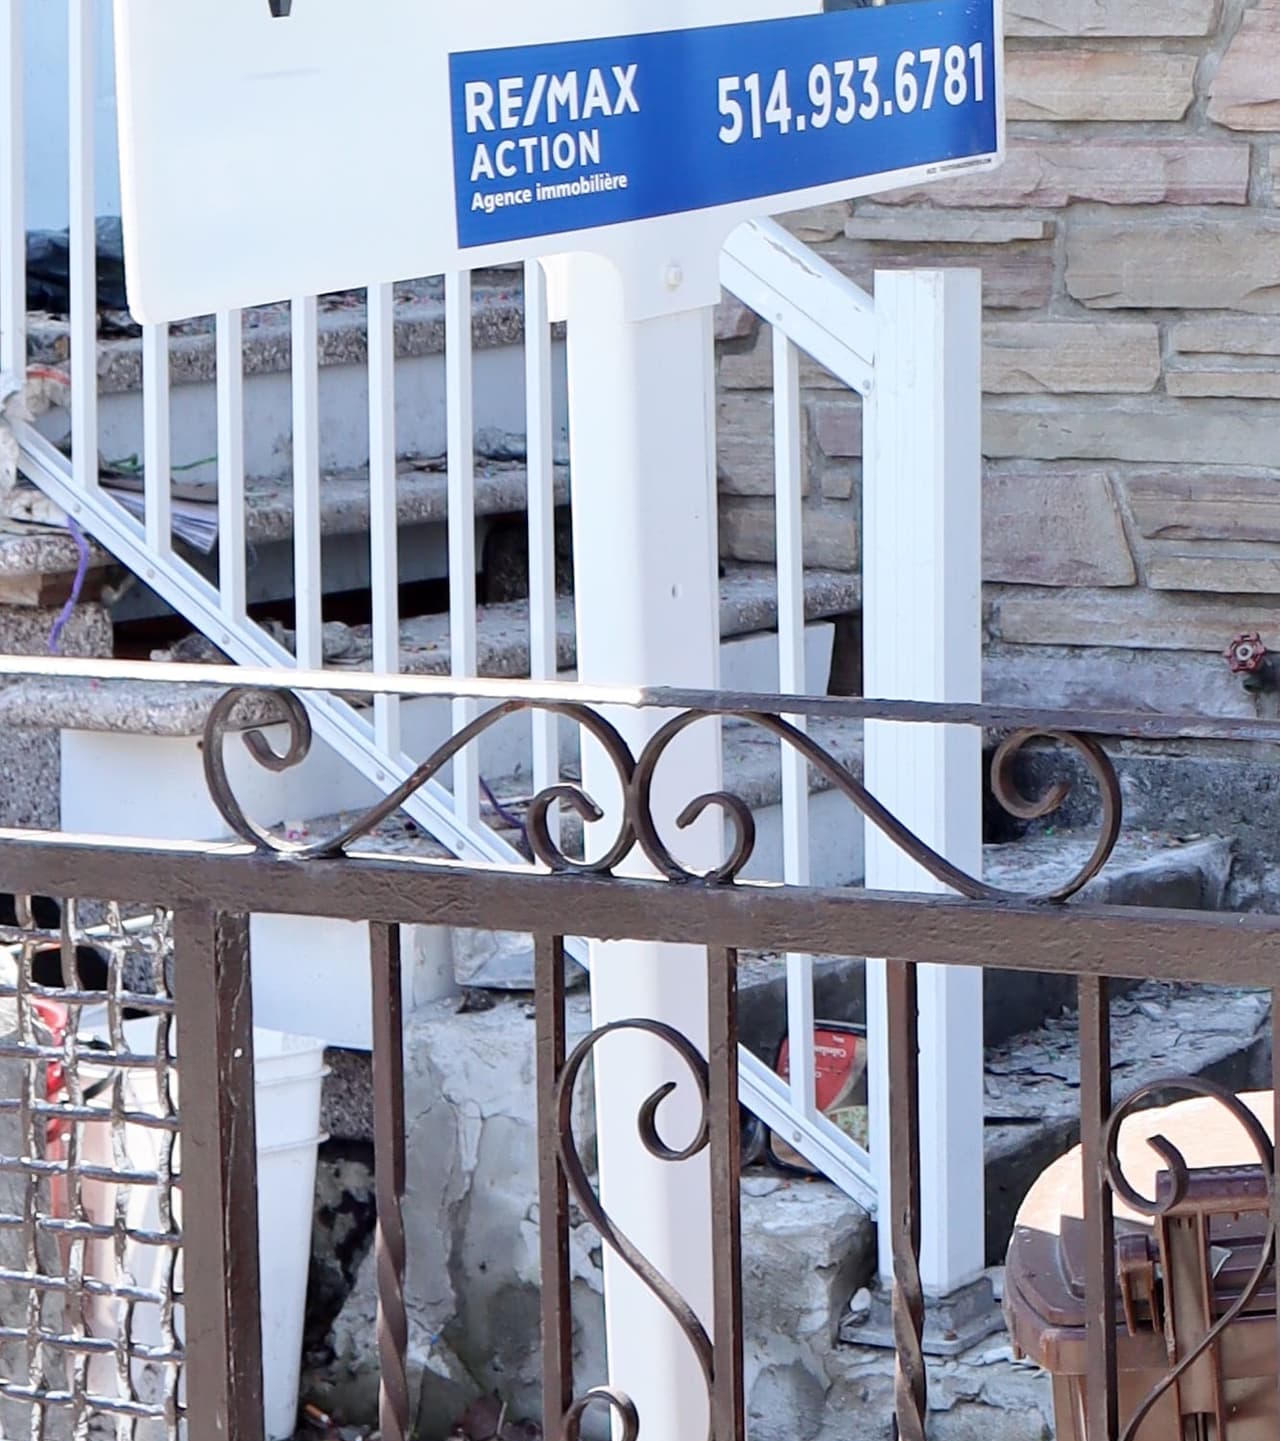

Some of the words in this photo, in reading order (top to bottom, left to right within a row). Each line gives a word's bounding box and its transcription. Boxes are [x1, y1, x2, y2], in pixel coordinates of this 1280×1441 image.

[463, 63, 641, 133] RE/MAX
[715, 41, 985, 145] 514.933.6781
[469, 129, 601, 184] ACTION
[471, 183, 533, 215] Agence
[535, 170, 629, 207] immobilière
